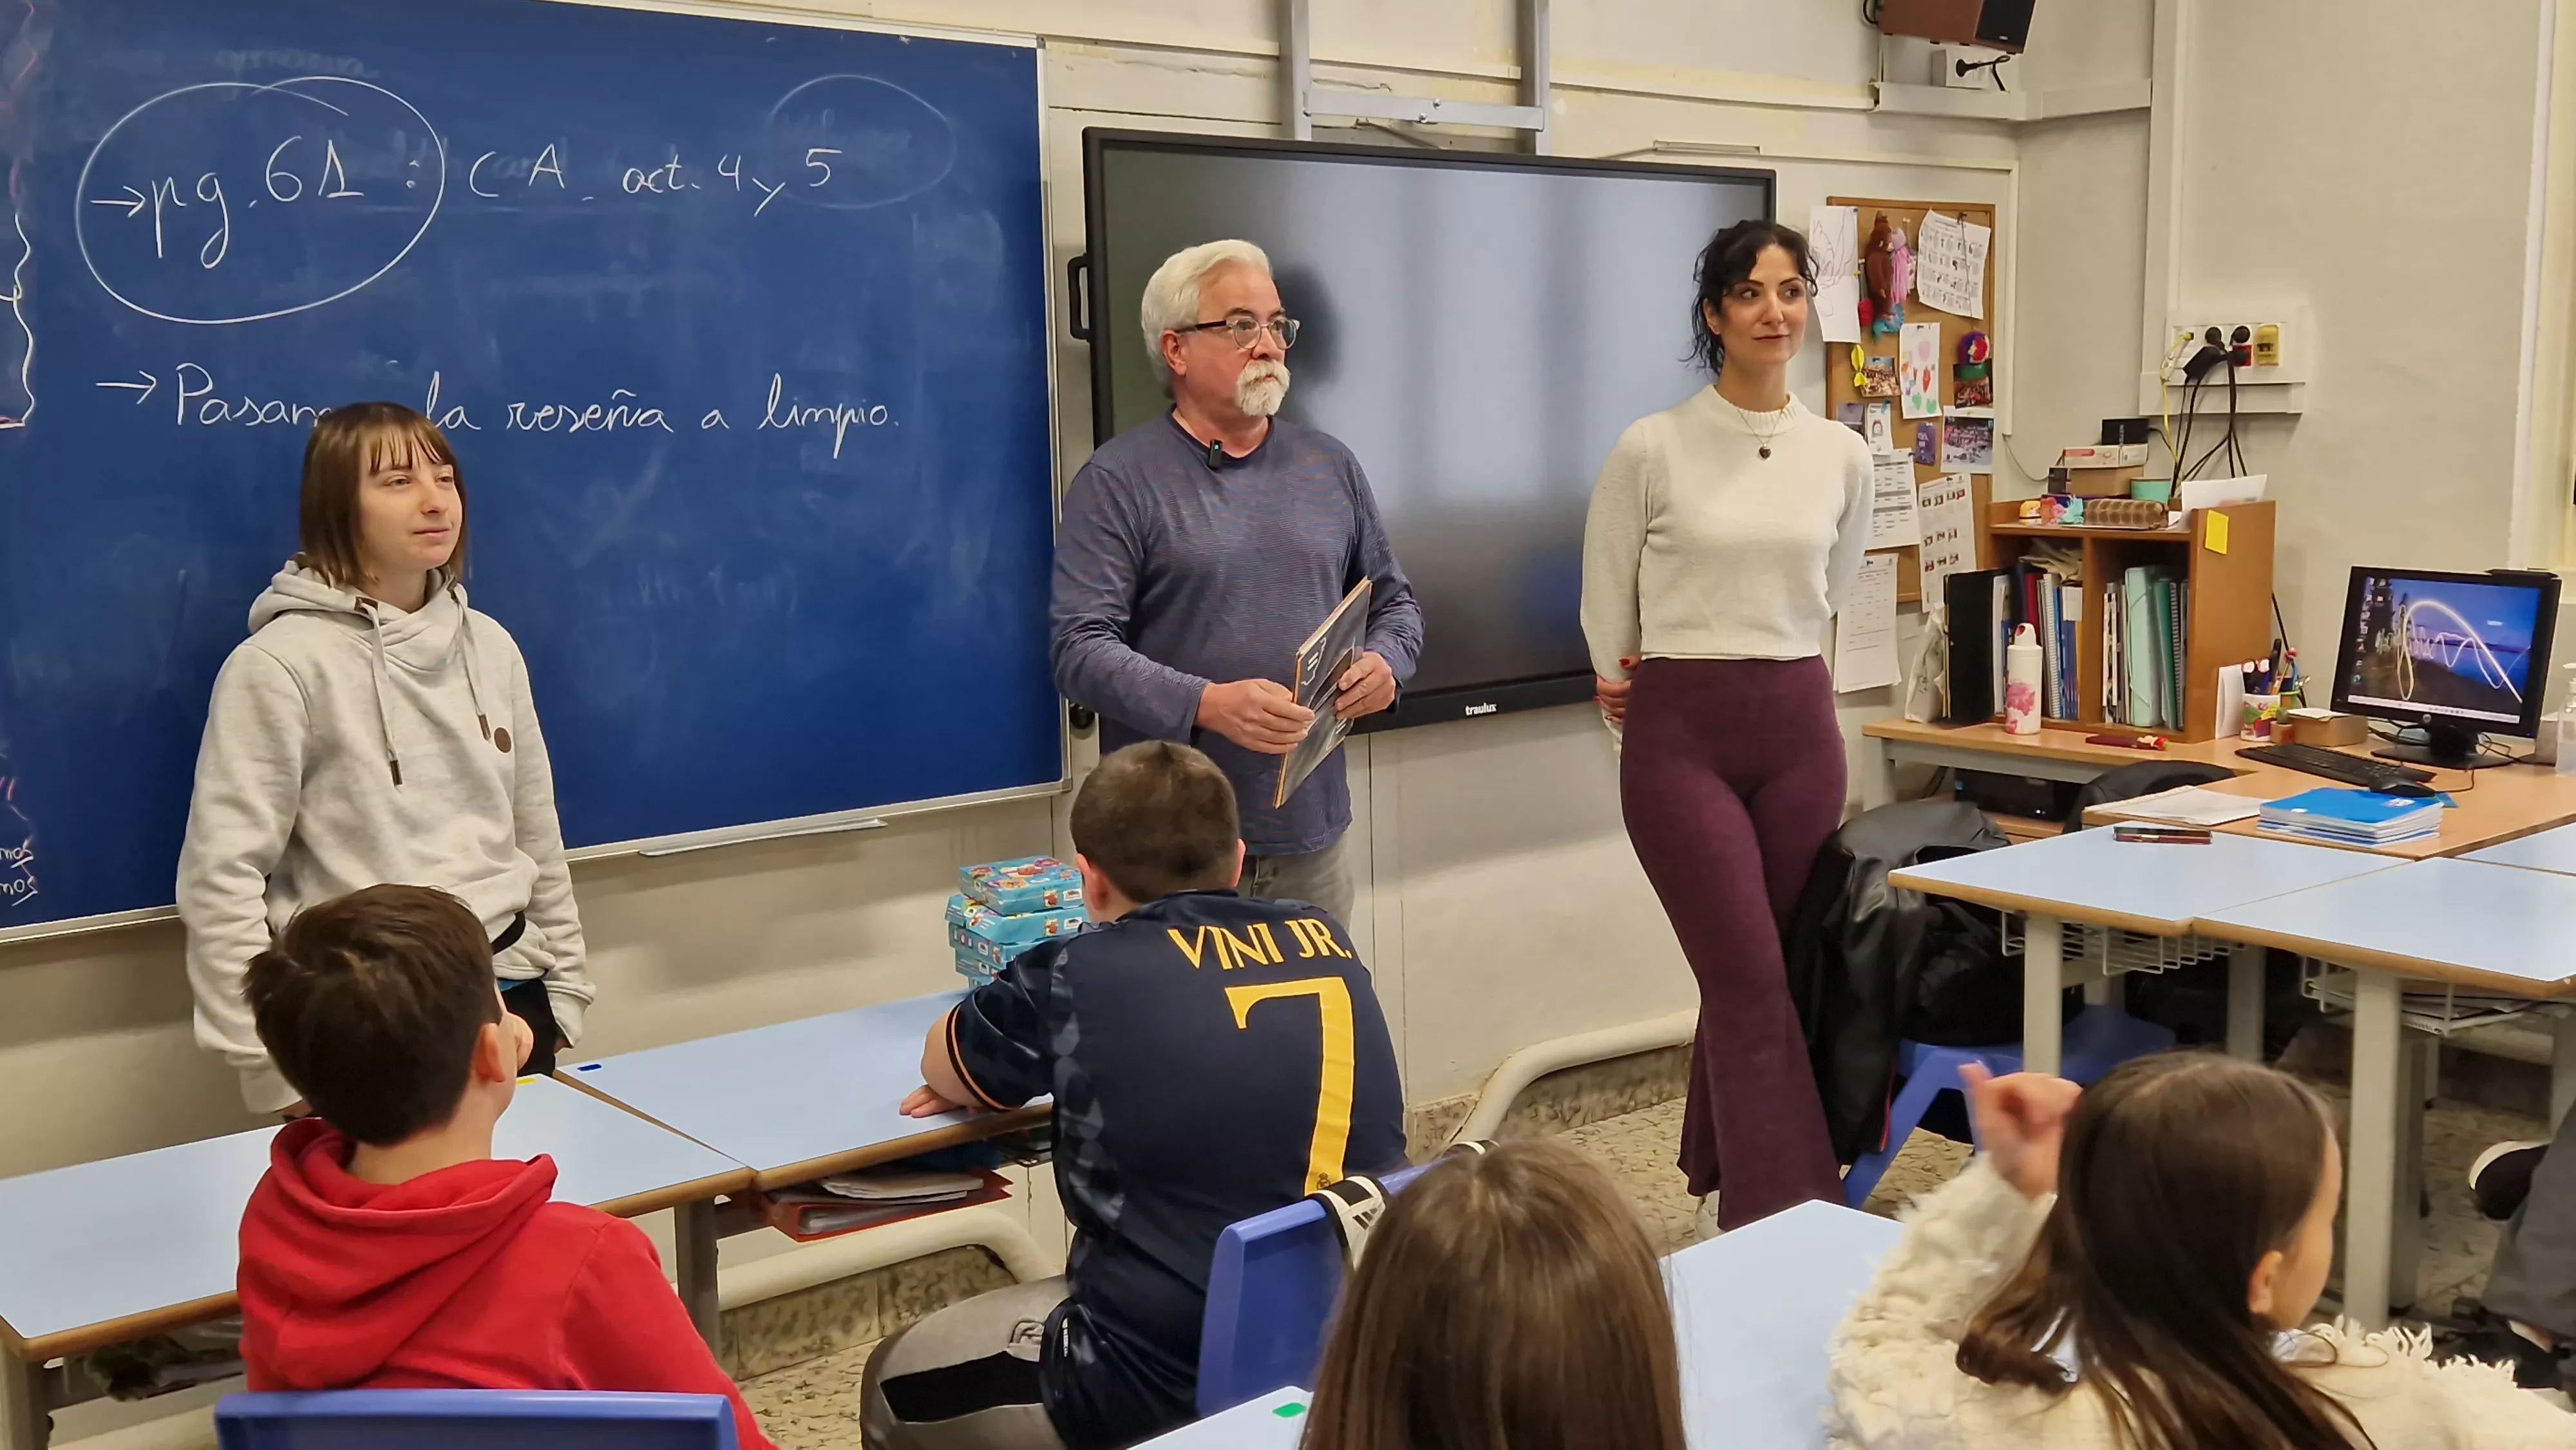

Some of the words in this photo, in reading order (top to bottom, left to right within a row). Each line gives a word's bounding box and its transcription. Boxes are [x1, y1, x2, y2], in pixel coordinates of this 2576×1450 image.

[717, 155, 741, 192] 4
[752, 177, 786, 217] y
[805, 147, 843, 187] 5
[425, 370, 482, 431] la
[506, 388, 674, 433] reseña
[701, 409, 730, 429] a
[1465, 702, 1497, 716] traulux
[1166, 923, 1285, 970] VINI
[1284, 918, 1352, 960] JR.
[1224, 976, 1355, 1196] 7
